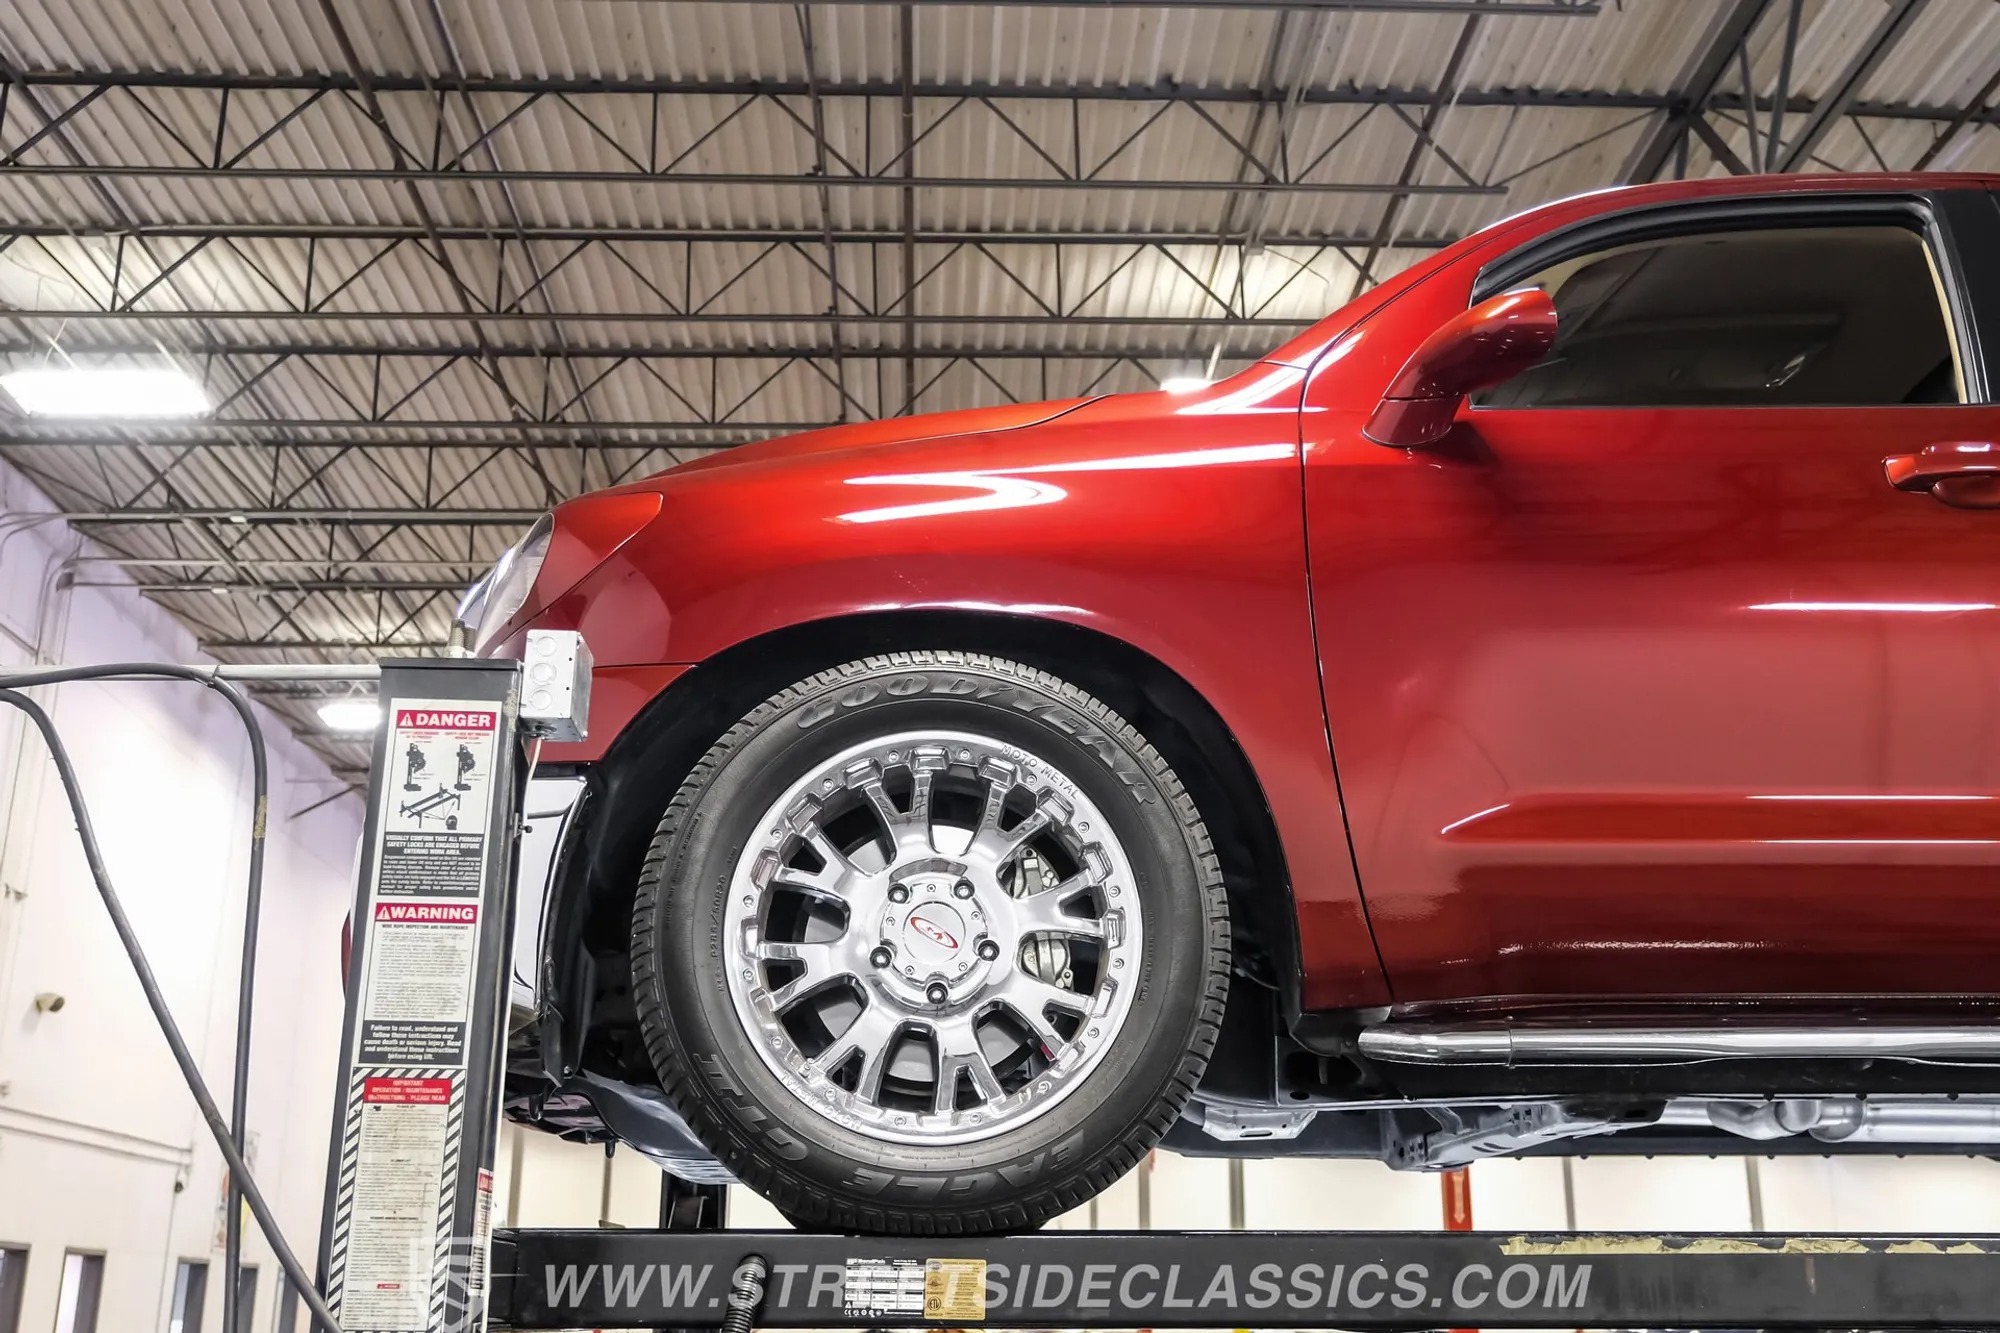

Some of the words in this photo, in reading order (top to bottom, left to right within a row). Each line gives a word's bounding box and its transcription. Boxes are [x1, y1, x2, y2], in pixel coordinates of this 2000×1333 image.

[416, 713, 491, 727] DANGER
[797, 674, 1156, 805] GOODYEAR
[1001, 744, 1038, 768] MOTO
[1040, 766, 1080, 800] METAL
[390, 907, 474, 920] WARNING
[842, 1129, 1085, 1197] EAGLE
